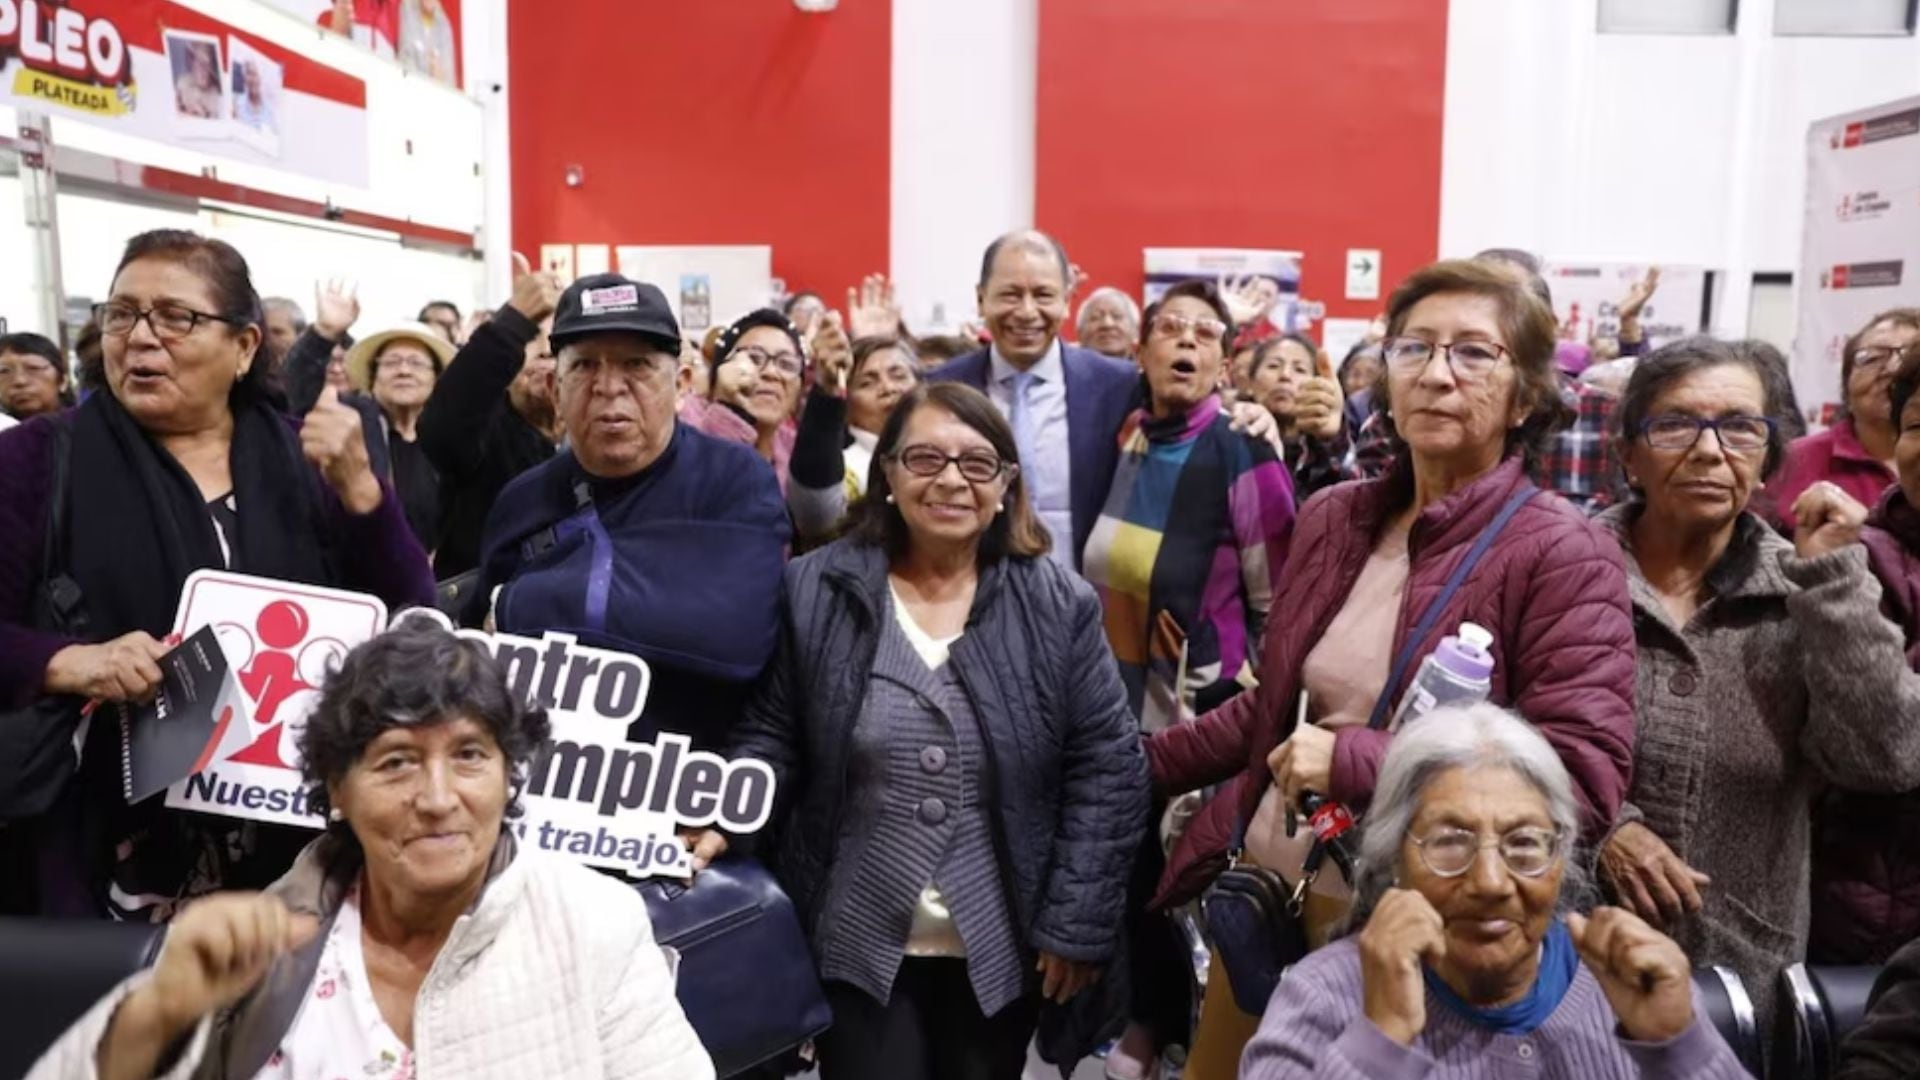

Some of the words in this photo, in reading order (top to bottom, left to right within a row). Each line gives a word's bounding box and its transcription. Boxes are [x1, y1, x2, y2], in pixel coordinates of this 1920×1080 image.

[32, 78, 109, 109] PLATEADA
[526, 741, 768, 825] mpleo
[538, 821, 686, 870] trabajo.
